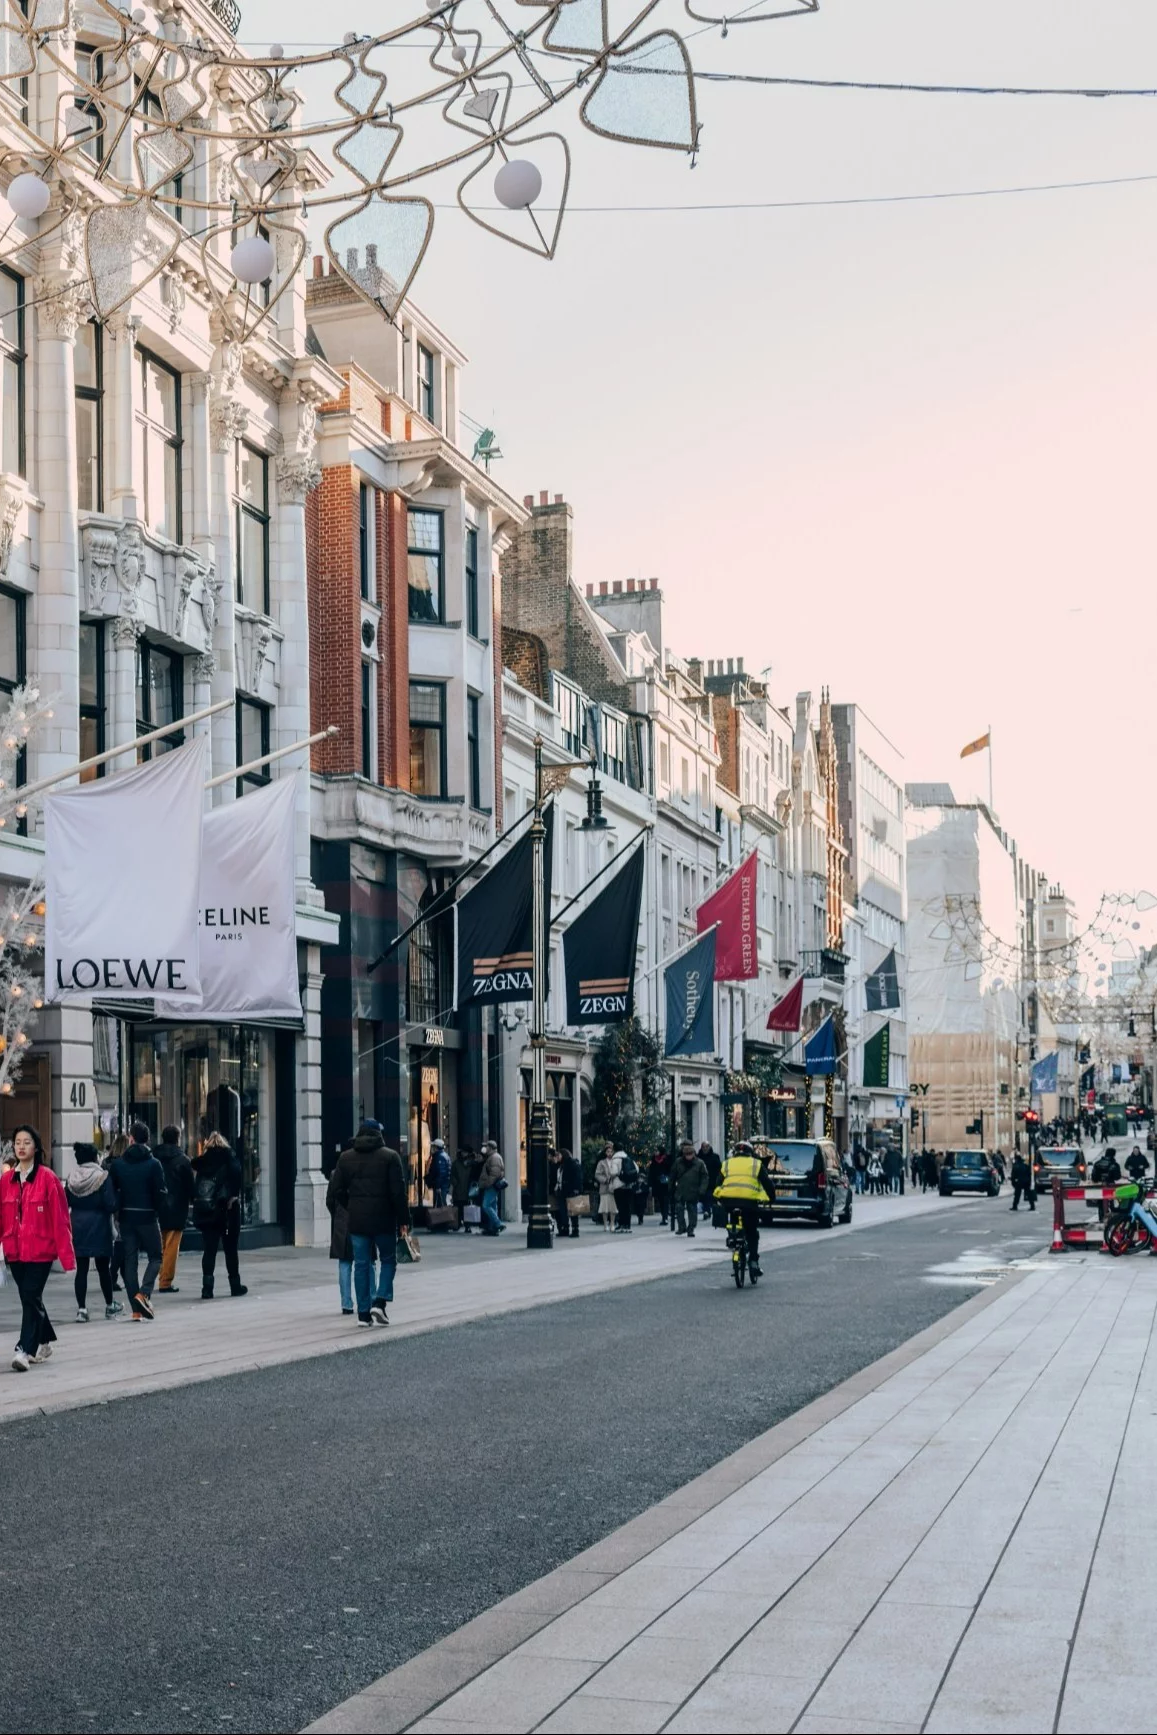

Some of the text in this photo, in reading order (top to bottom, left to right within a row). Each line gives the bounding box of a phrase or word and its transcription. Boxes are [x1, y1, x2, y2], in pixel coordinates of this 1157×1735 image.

[741, 876, 752, 974] RICHARD GREEN
[55, 958, 187, 990] LOEWE
[473, 971, 533, 996] ZEGNA
[425, 1028, 444, 1045] ZEGNA
[70, 1082, 85, 1107] 40
